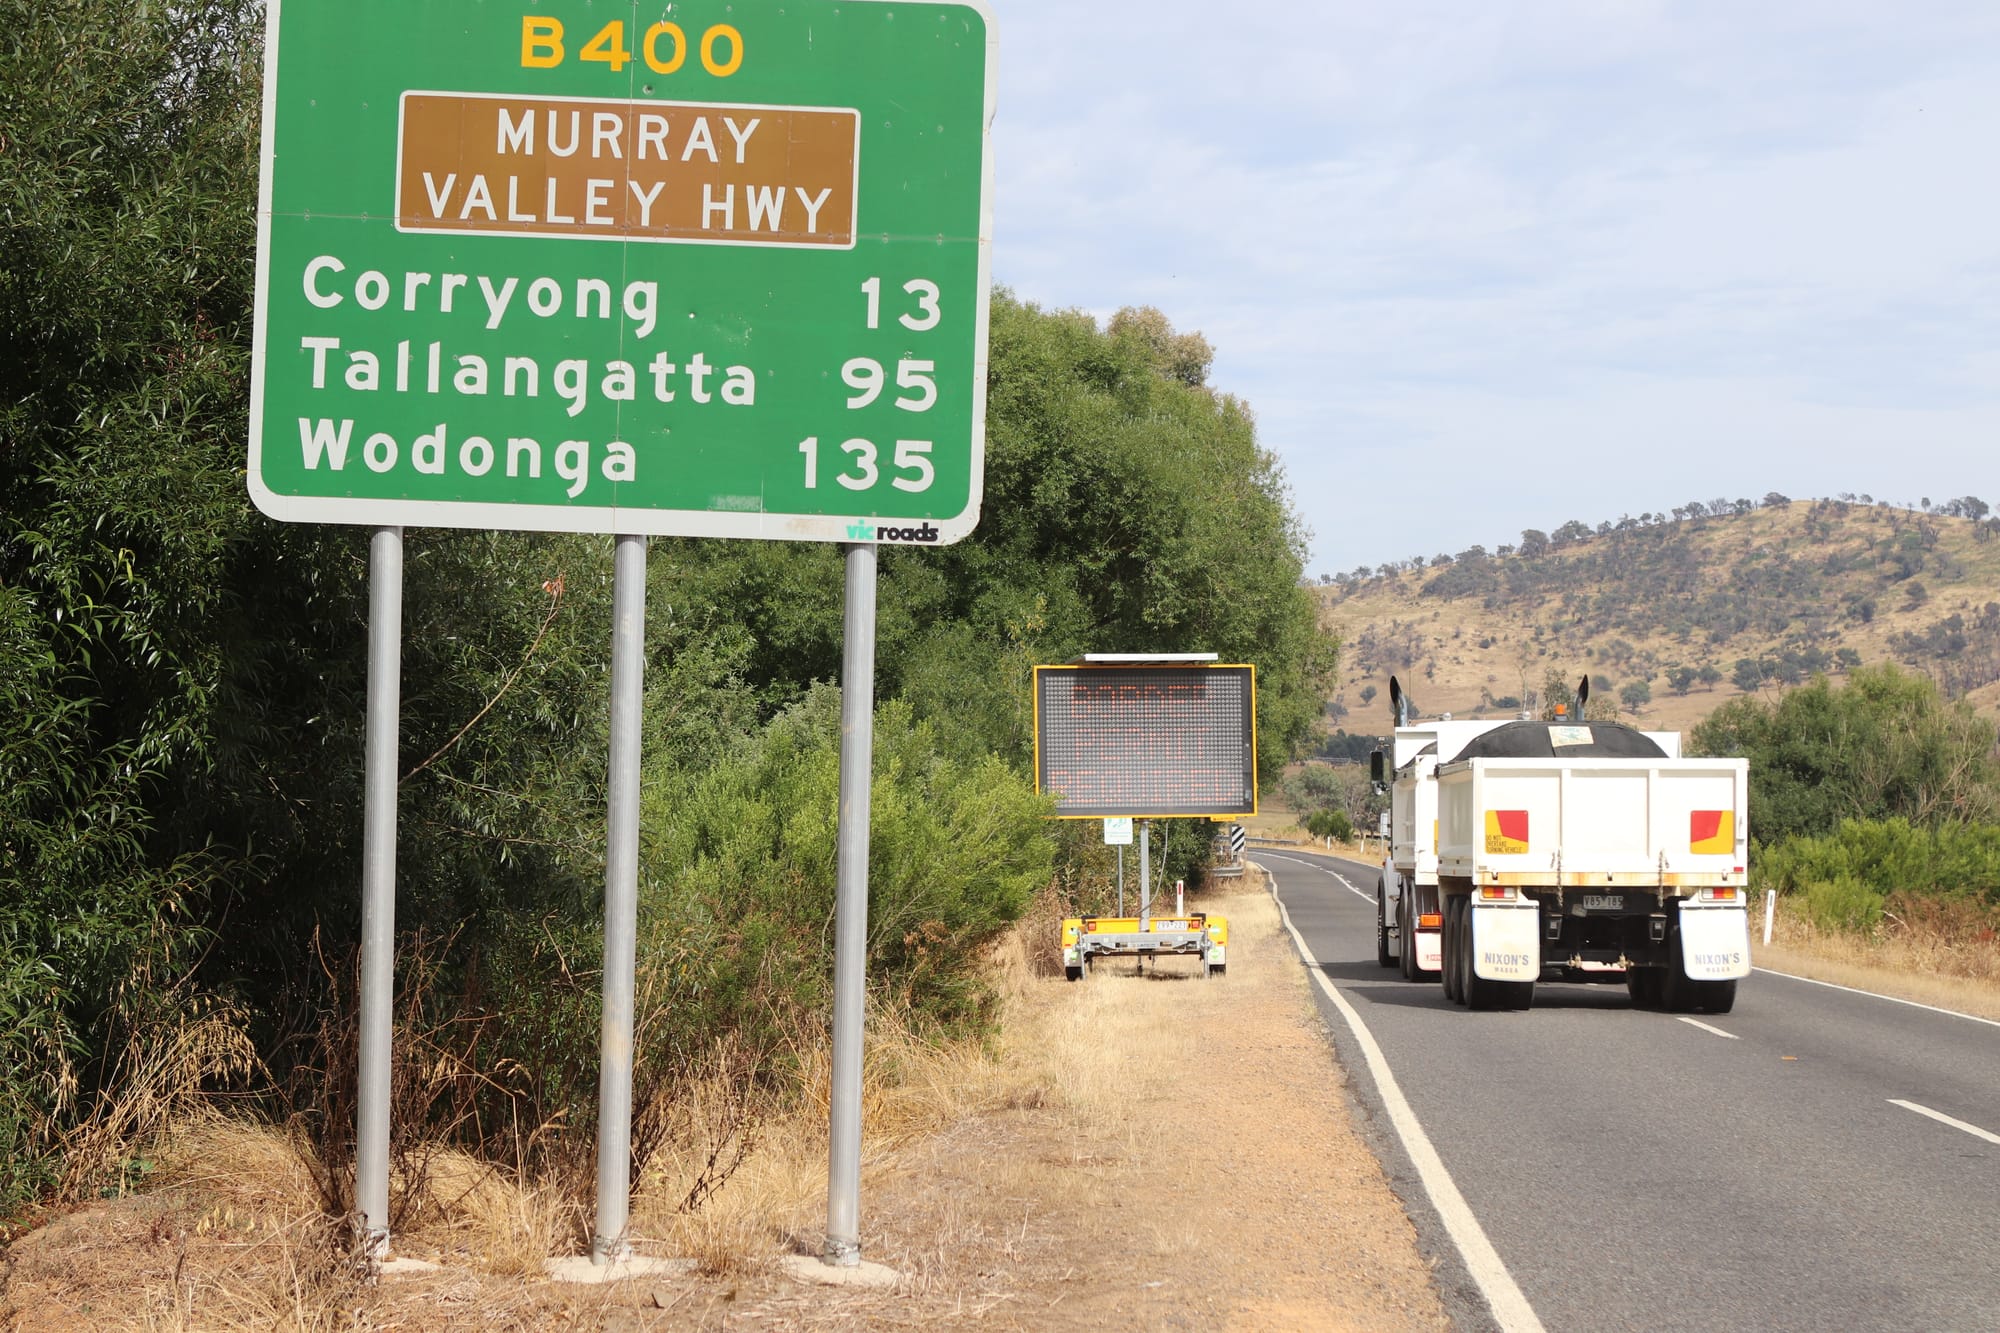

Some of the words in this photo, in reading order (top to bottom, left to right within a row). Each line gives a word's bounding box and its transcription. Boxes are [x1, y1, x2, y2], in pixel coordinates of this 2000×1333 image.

[521, 15, 744, 77] B400
[497, 107, 761, 164] MURRAY
[422, 172, 666, 227] VALLEY
[702, 183, 832, 234] HWY
[302, 255, 659, 339] Corryong
[861, 276, 942, 332] 13
[301, 336, 757, 417] Tallangatta
[841, 357, 938, 412] 95
[298, 417, 638, 499] Wodonga
[798, 436, 935, 493] 135
[1071, 685, 1214, 718] BORDER
[1075, 727, 1212, 760] PERMIT
[1485, 952, 1529, 966] NIXON'S
[1695, 952, 1740, 966] NIXON'S
